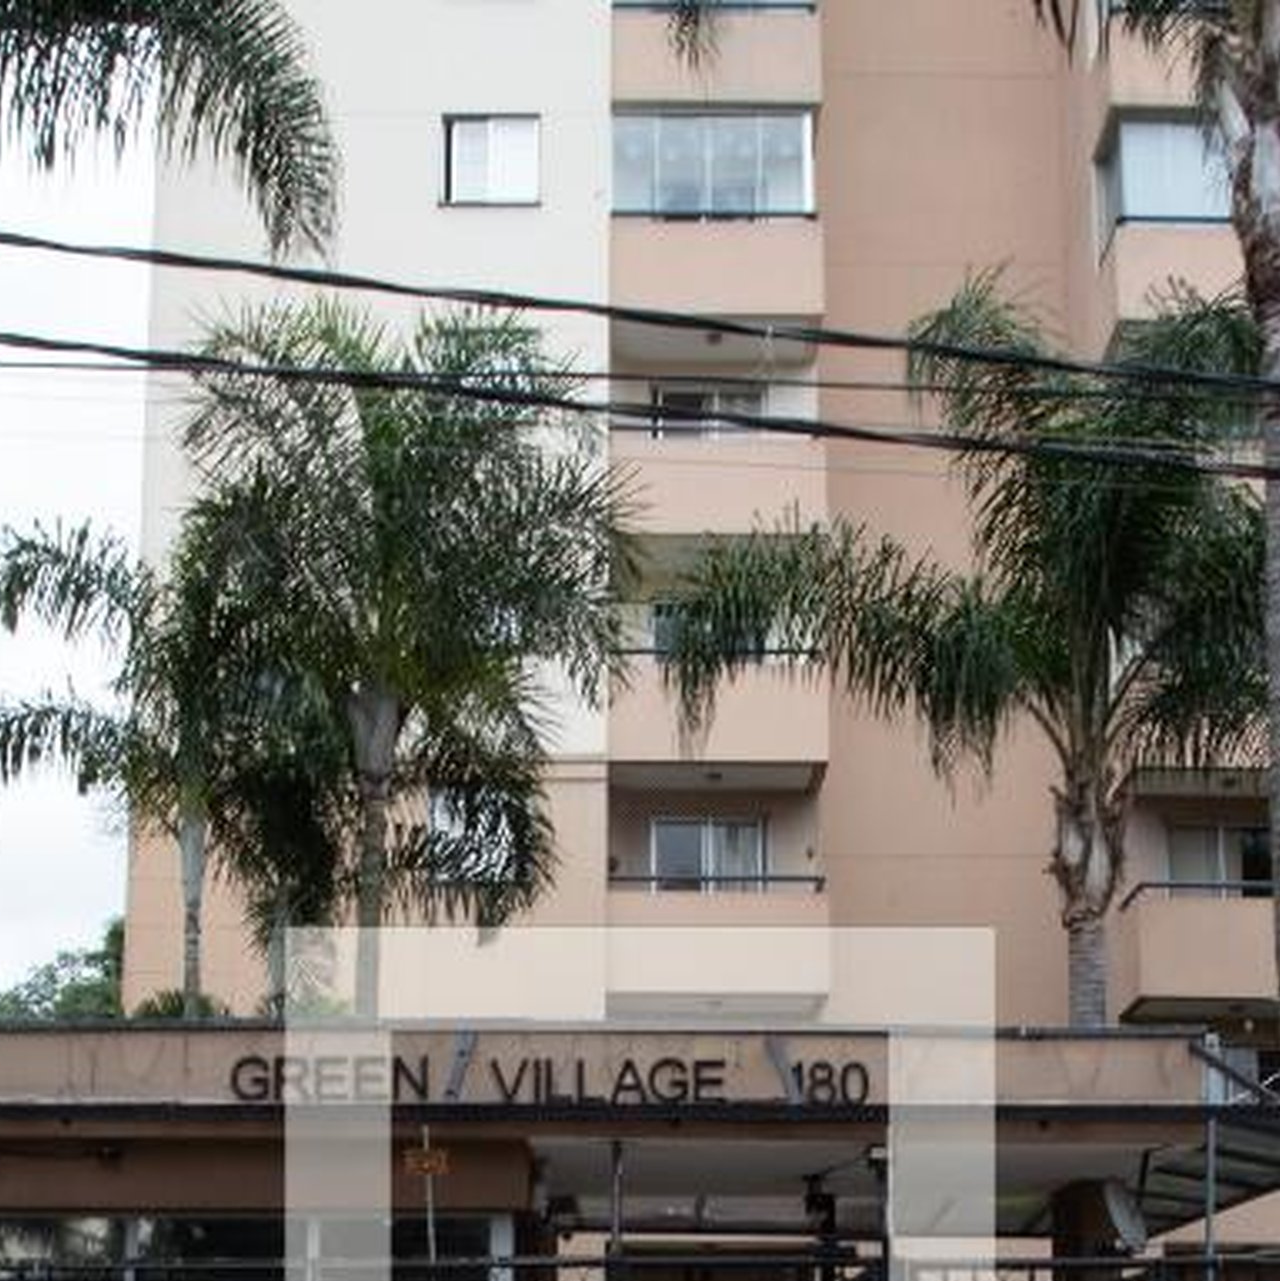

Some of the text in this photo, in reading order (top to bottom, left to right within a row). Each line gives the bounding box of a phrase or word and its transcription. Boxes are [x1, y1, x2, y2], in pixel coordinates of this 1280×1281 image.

[230, 1055, 870, 1102] GREEN VILLAGE 180
